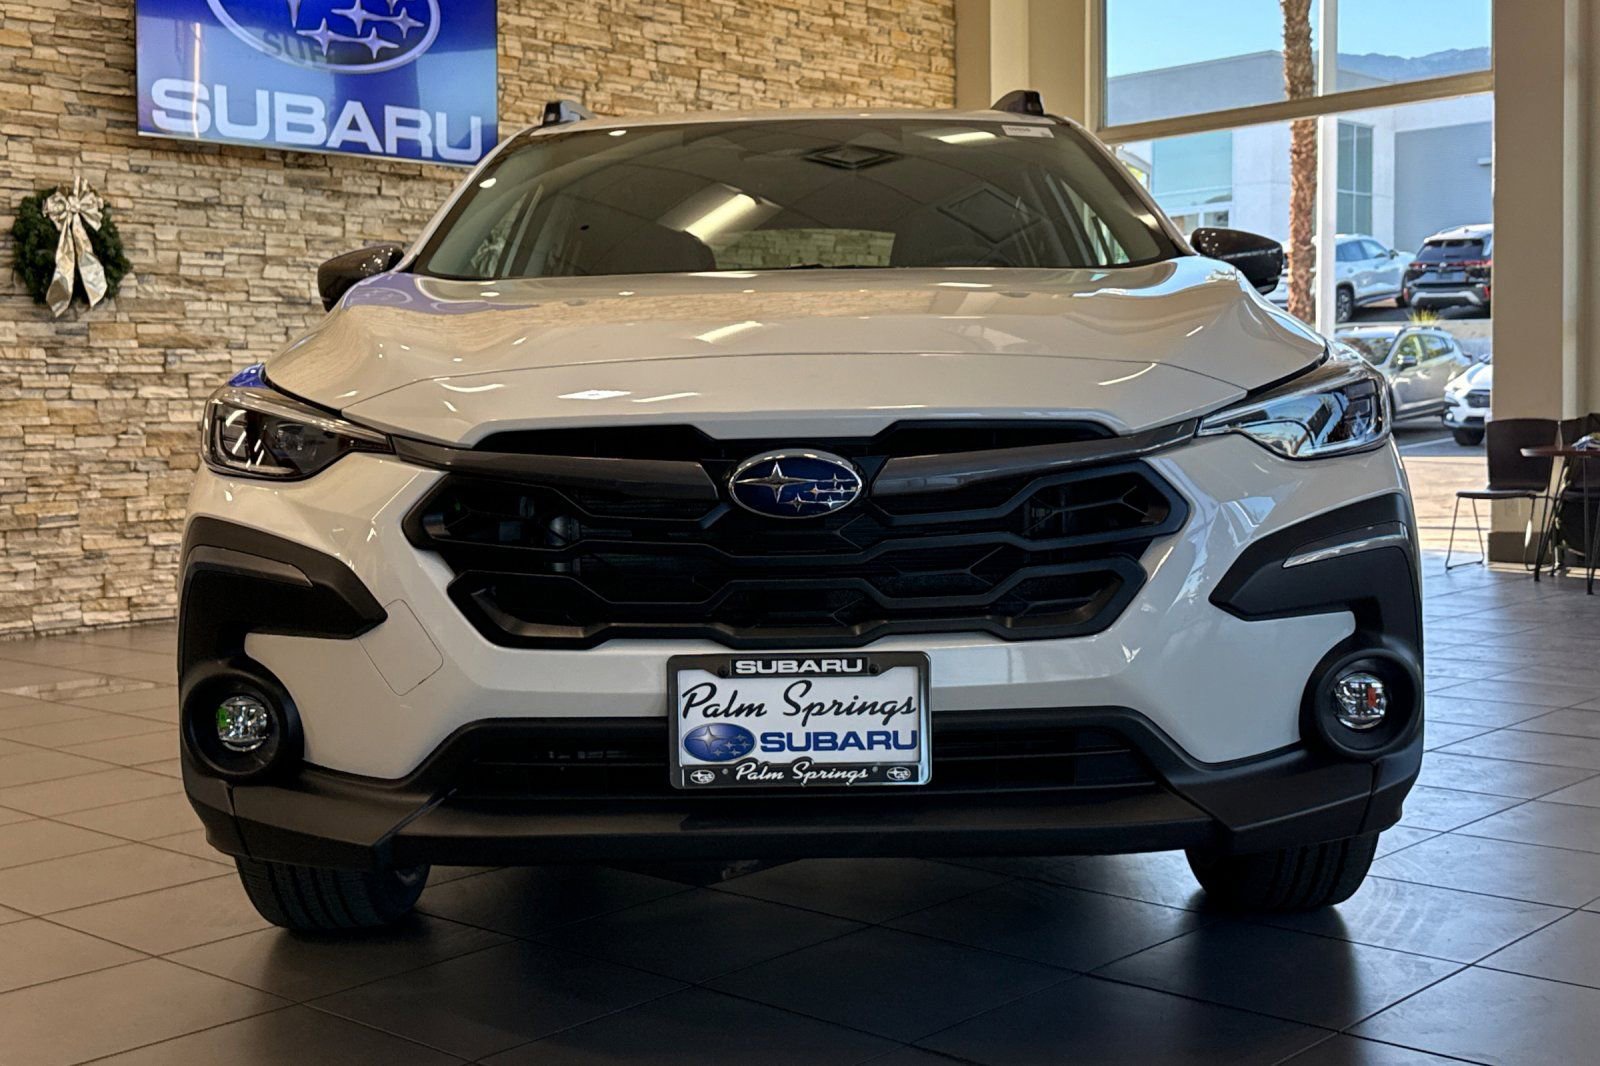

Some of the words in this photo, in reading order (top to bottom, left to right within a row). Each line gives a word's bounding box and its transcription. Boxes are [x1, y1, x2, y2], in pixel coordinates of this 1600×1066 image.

[151, 78, 483, 162] SUBARU
[735, 659, 863, 674] SUBARU
[682, 682, 768, 719] Palm
[783, 679, 917, 727] Springs
[760, 730, 918, 752] SUBARU
[735, 761, 785, 781] Palm
[792, 761, 869, 786] Springs
